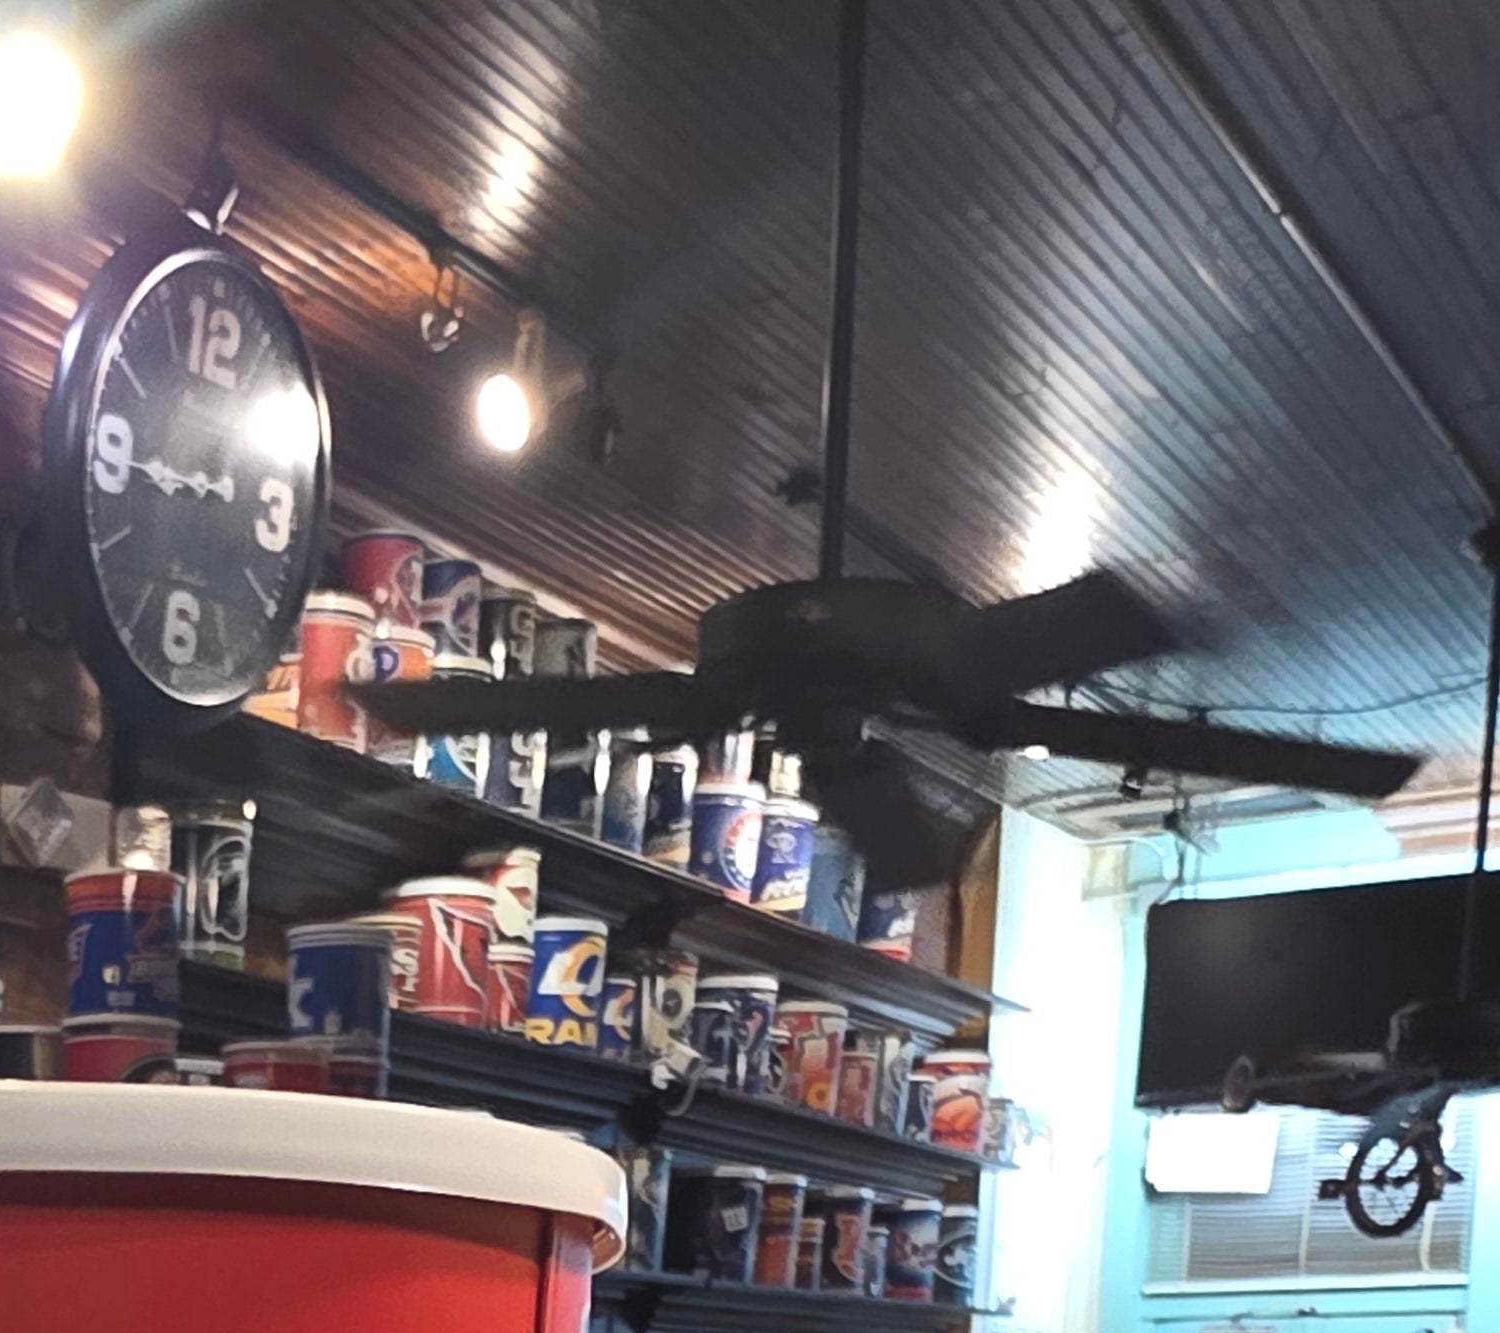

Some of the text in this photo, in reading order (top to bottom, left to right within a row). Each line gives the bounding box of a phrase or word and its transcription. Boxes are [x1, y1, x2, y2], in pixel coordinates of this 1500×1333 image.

[189, 296, 241, 389] 12
[94, 413, 133, 494] 9
[255, 479, 295, 553] 3
[163, 590, 199, 665] 6
